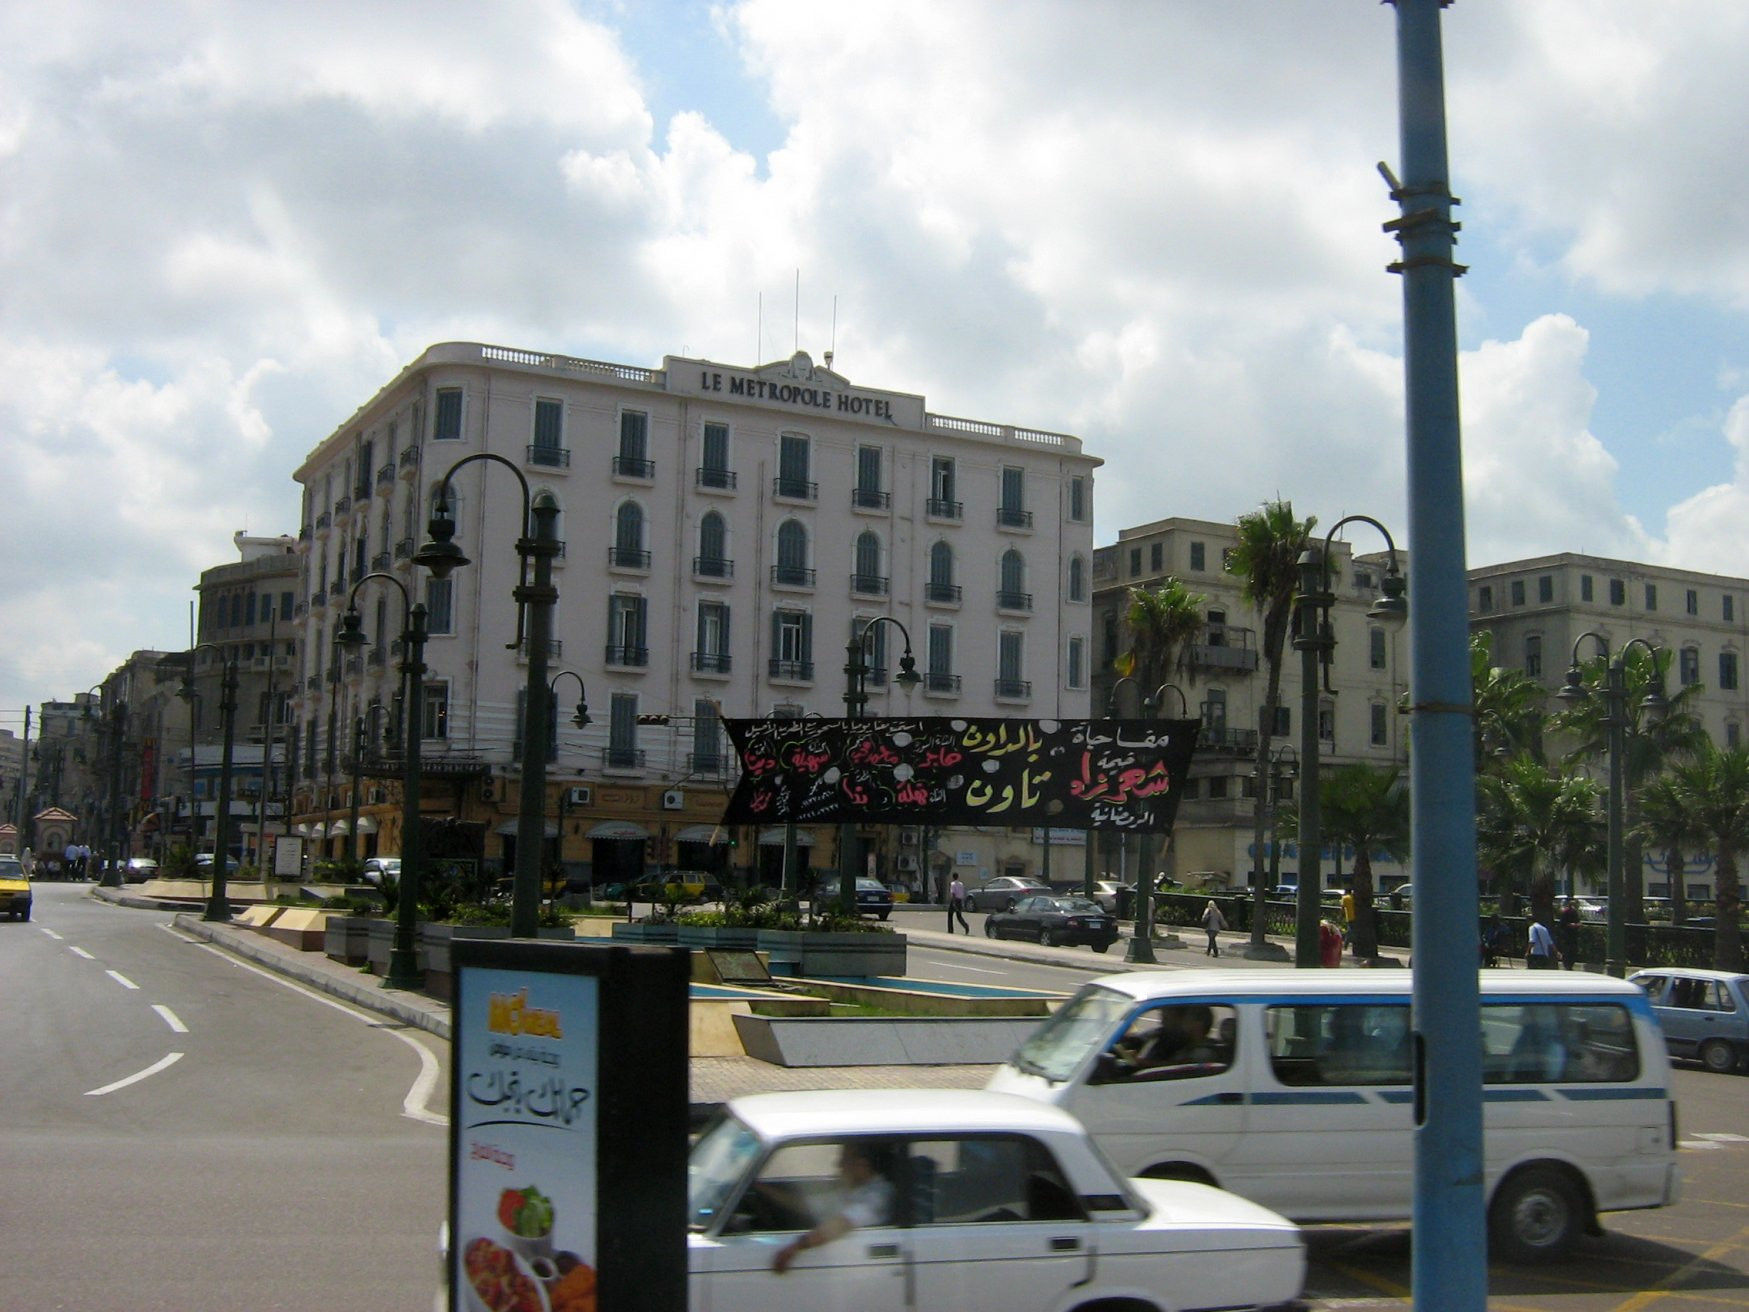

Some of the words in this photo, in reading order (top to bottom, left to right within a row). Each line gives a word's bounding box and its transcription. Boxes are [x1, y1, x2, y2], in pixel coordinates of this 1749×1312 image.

[702, 371, 722, 392] LE
[730, 376, 831, 410] METROPOLE
[837, 394, 893, 419] HOTEL
[965, 768, 1053, 813] تاون
